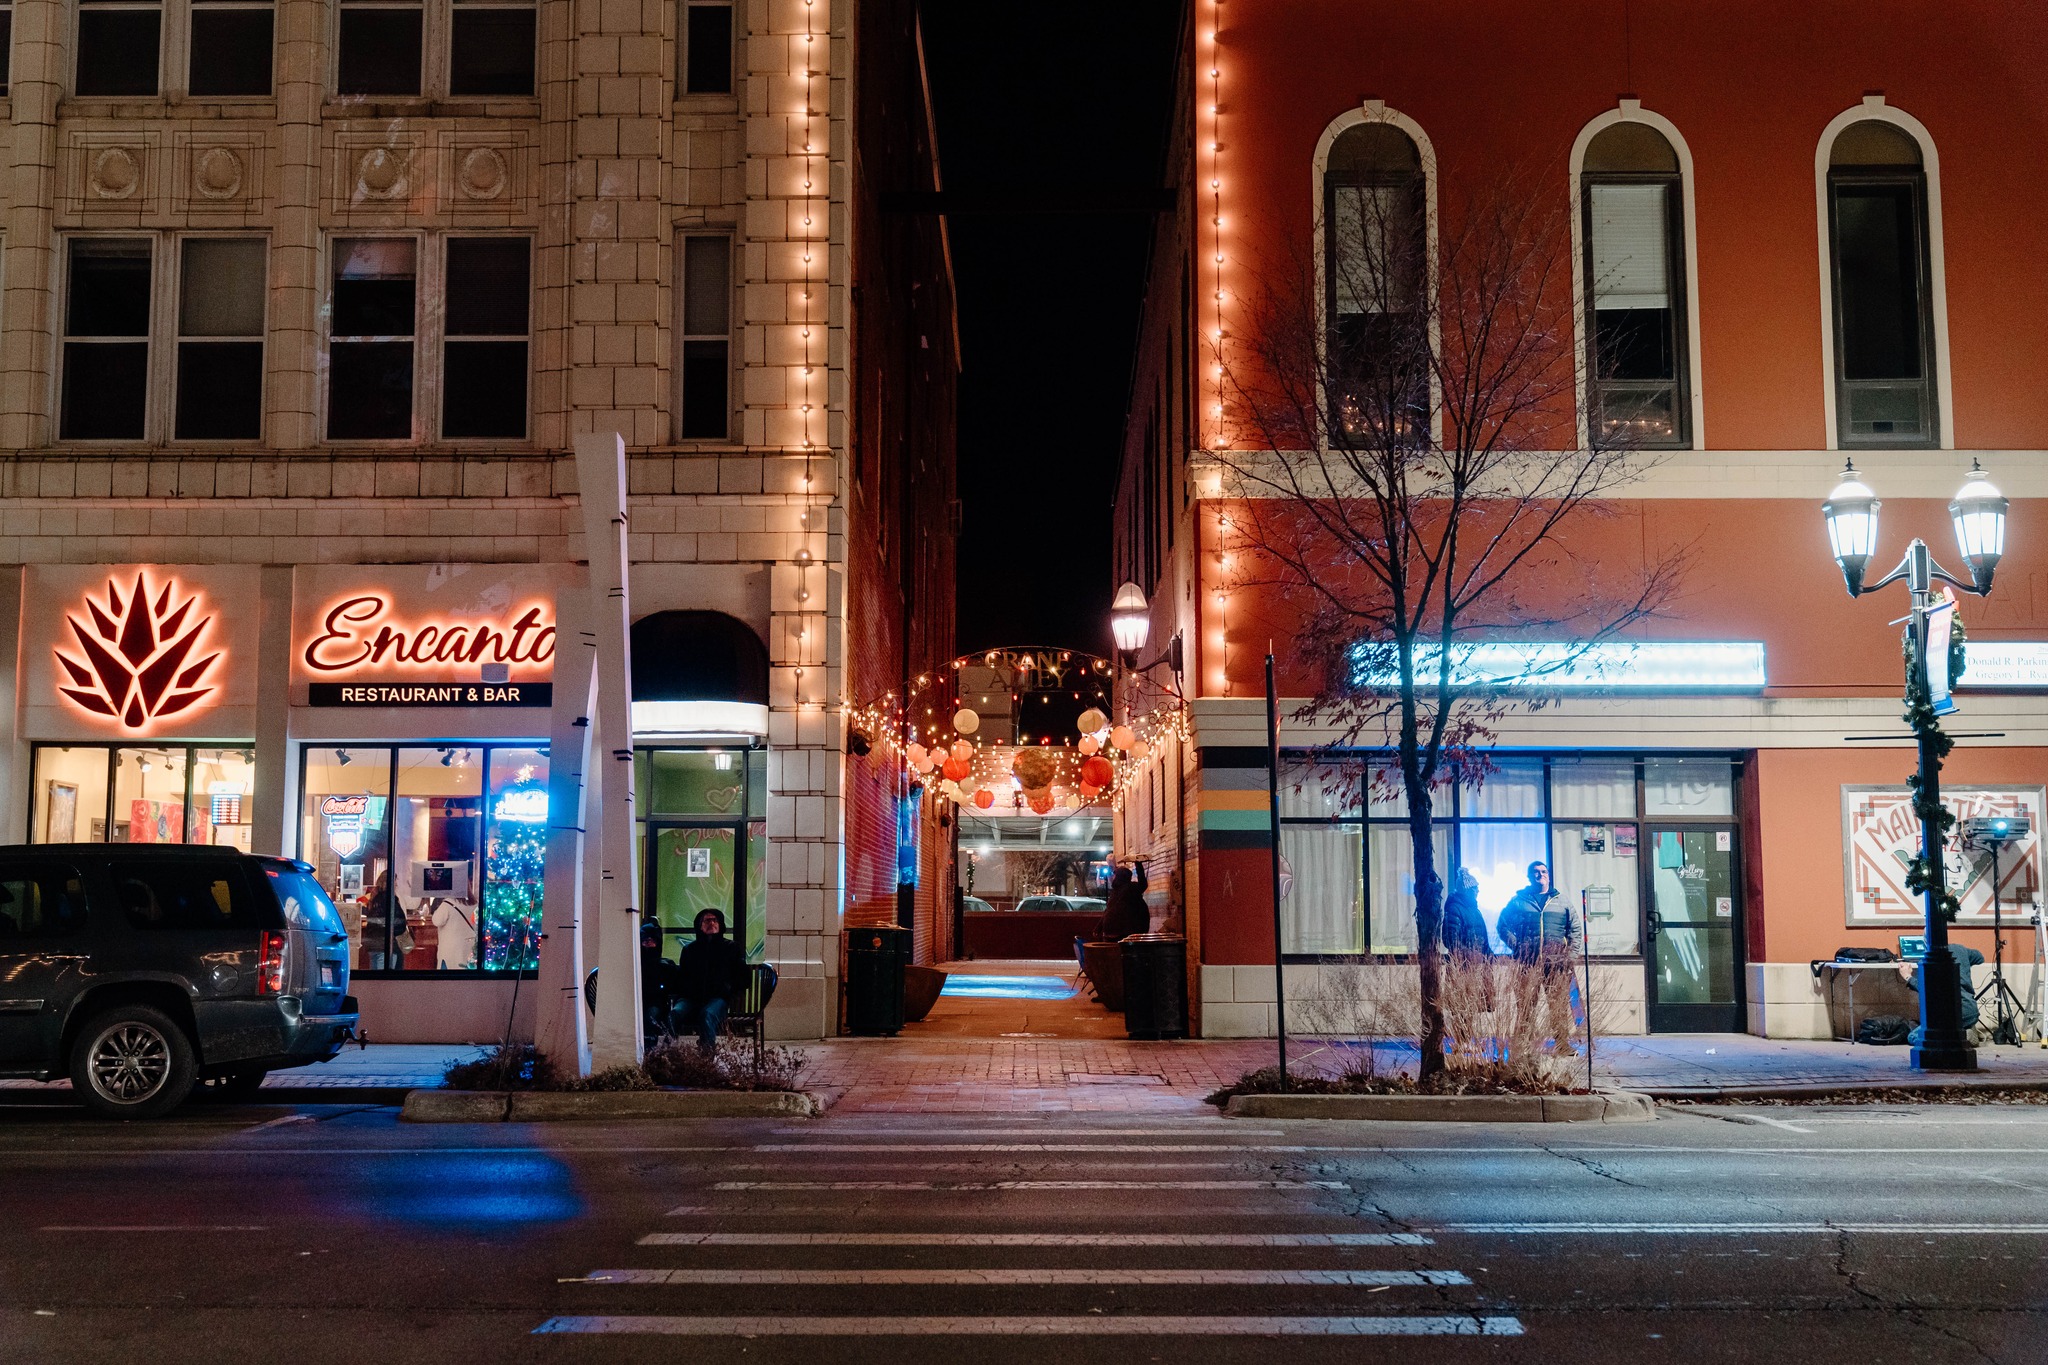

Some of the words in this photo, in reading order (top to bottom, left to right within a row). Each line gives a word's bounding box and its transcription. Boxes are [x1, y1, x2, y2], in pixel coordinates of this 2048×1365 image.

[305, 596, 556, 670] Encanto
[984, 651, 1071, 671] CRANE
[1967, 656, 2002, 666] Donald
[987, 668, 1071, 689] AEY
[1975, 669, 2013, 682] Gregory
[341, 687, 462, 702] RESTAURANT
[467, 687, 479, 702] &
[483, 687, 521, 702] BAR
[1660, 771, 1716, 806] 119
